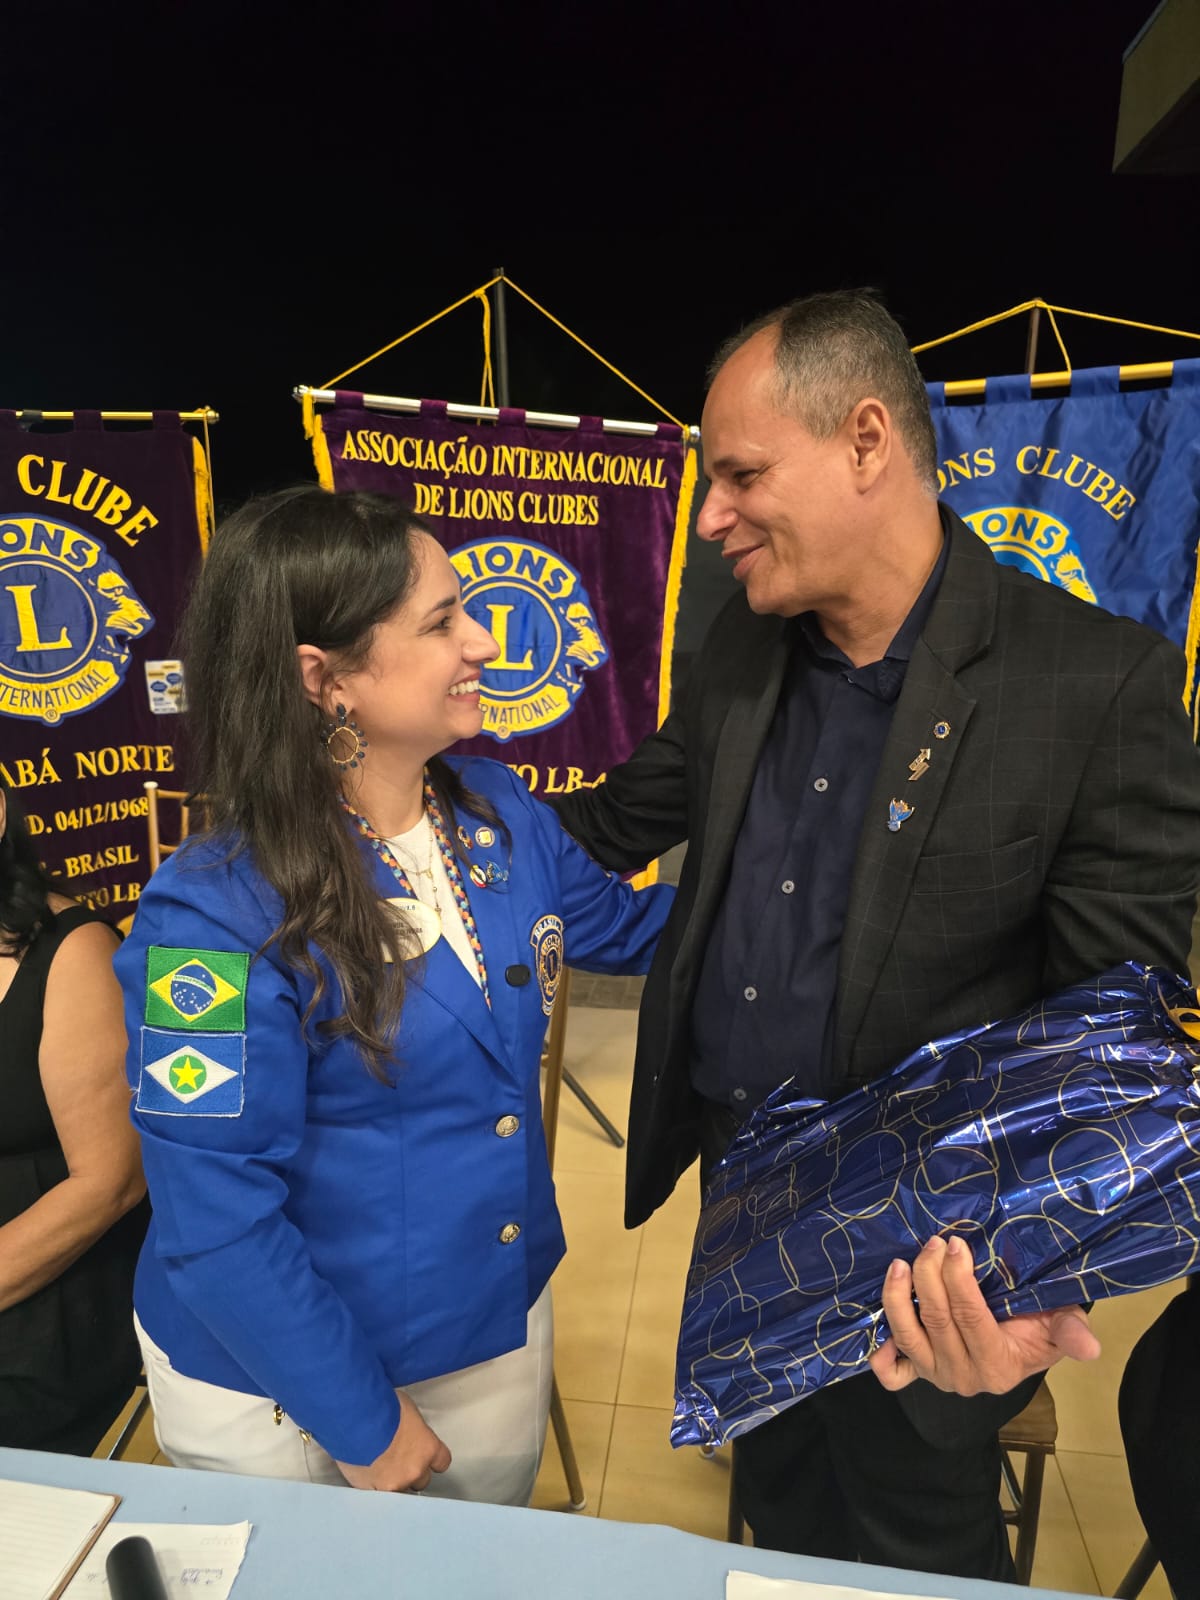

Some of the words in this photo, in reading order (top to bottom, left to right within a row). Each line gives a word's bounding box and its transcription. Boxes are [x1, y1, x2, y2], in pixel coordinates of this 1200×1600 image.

[341, 430, 487, 479] ASSOCIAÇÃO
[491, 445, 667, 488] INTERNACIONAL
[1016, 445, 1136, 520] CLUBE
[17, 454, 159, 547] CLUBE
[413, 482, 445, 516] DE
[448, 487, 514, 521] LIONS
[518, 491, 599, 525] CLUBES
[5, 585, 73, 652] L
[484, 604, 534, 671] L
[74, 744, 175, 779] NORTE
[506, 764, 539, 793] O
[55, 797, 149, 832] 04/12/1968
[64, 845, 140, 878] BRASIL
